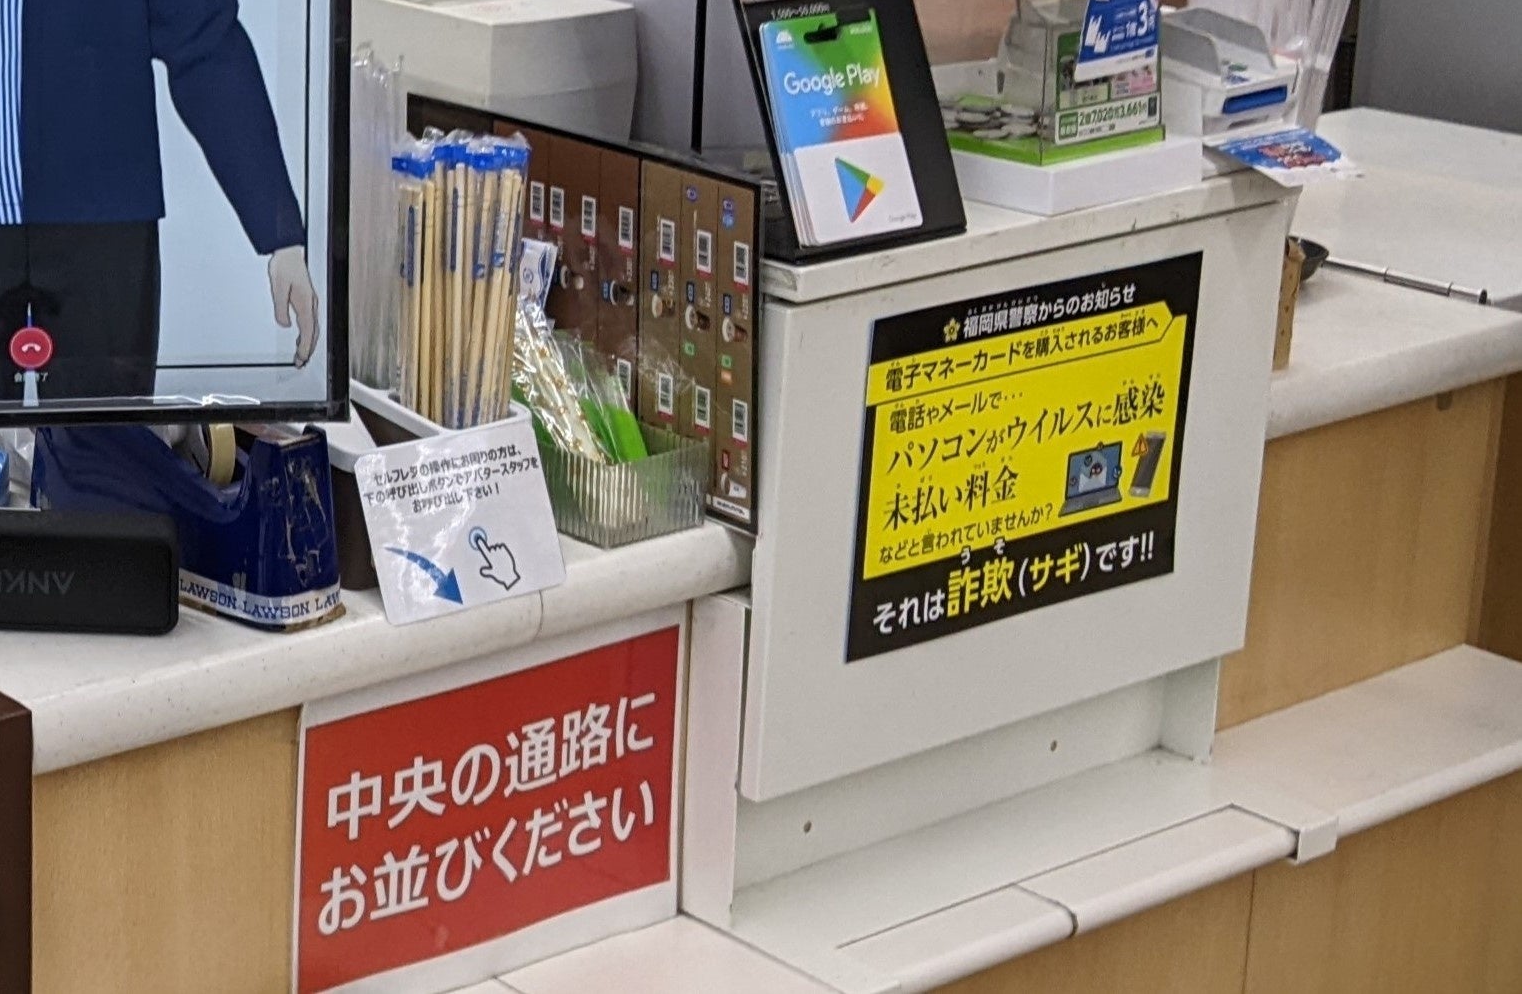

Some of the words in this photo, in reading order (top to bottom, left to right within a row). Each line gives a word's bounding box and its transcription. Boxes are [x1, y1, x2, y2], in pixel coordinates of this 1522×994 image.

[783, 66, 845, 96] Google
[845, 62, 880, 88] Play
[962, 287, 1136, 340] 福岡県警察からのお知らせ
[884, 314, 1160, 394] 電子マネーカードを購入されるお客様へ
[886, 380, 1166, 476] パソコンがウイルスに感染
[882, 463, 1020, 533] 未払い料金
[879, 502, 1055, 565] などと言われていませんか？
[179, 578, 238, 608] LAWSON
[242, 599, 310, 621] LAWSON
[326, 691, 657, 841] 中央の通路に
[316, 779, 655, 936] お並びください
